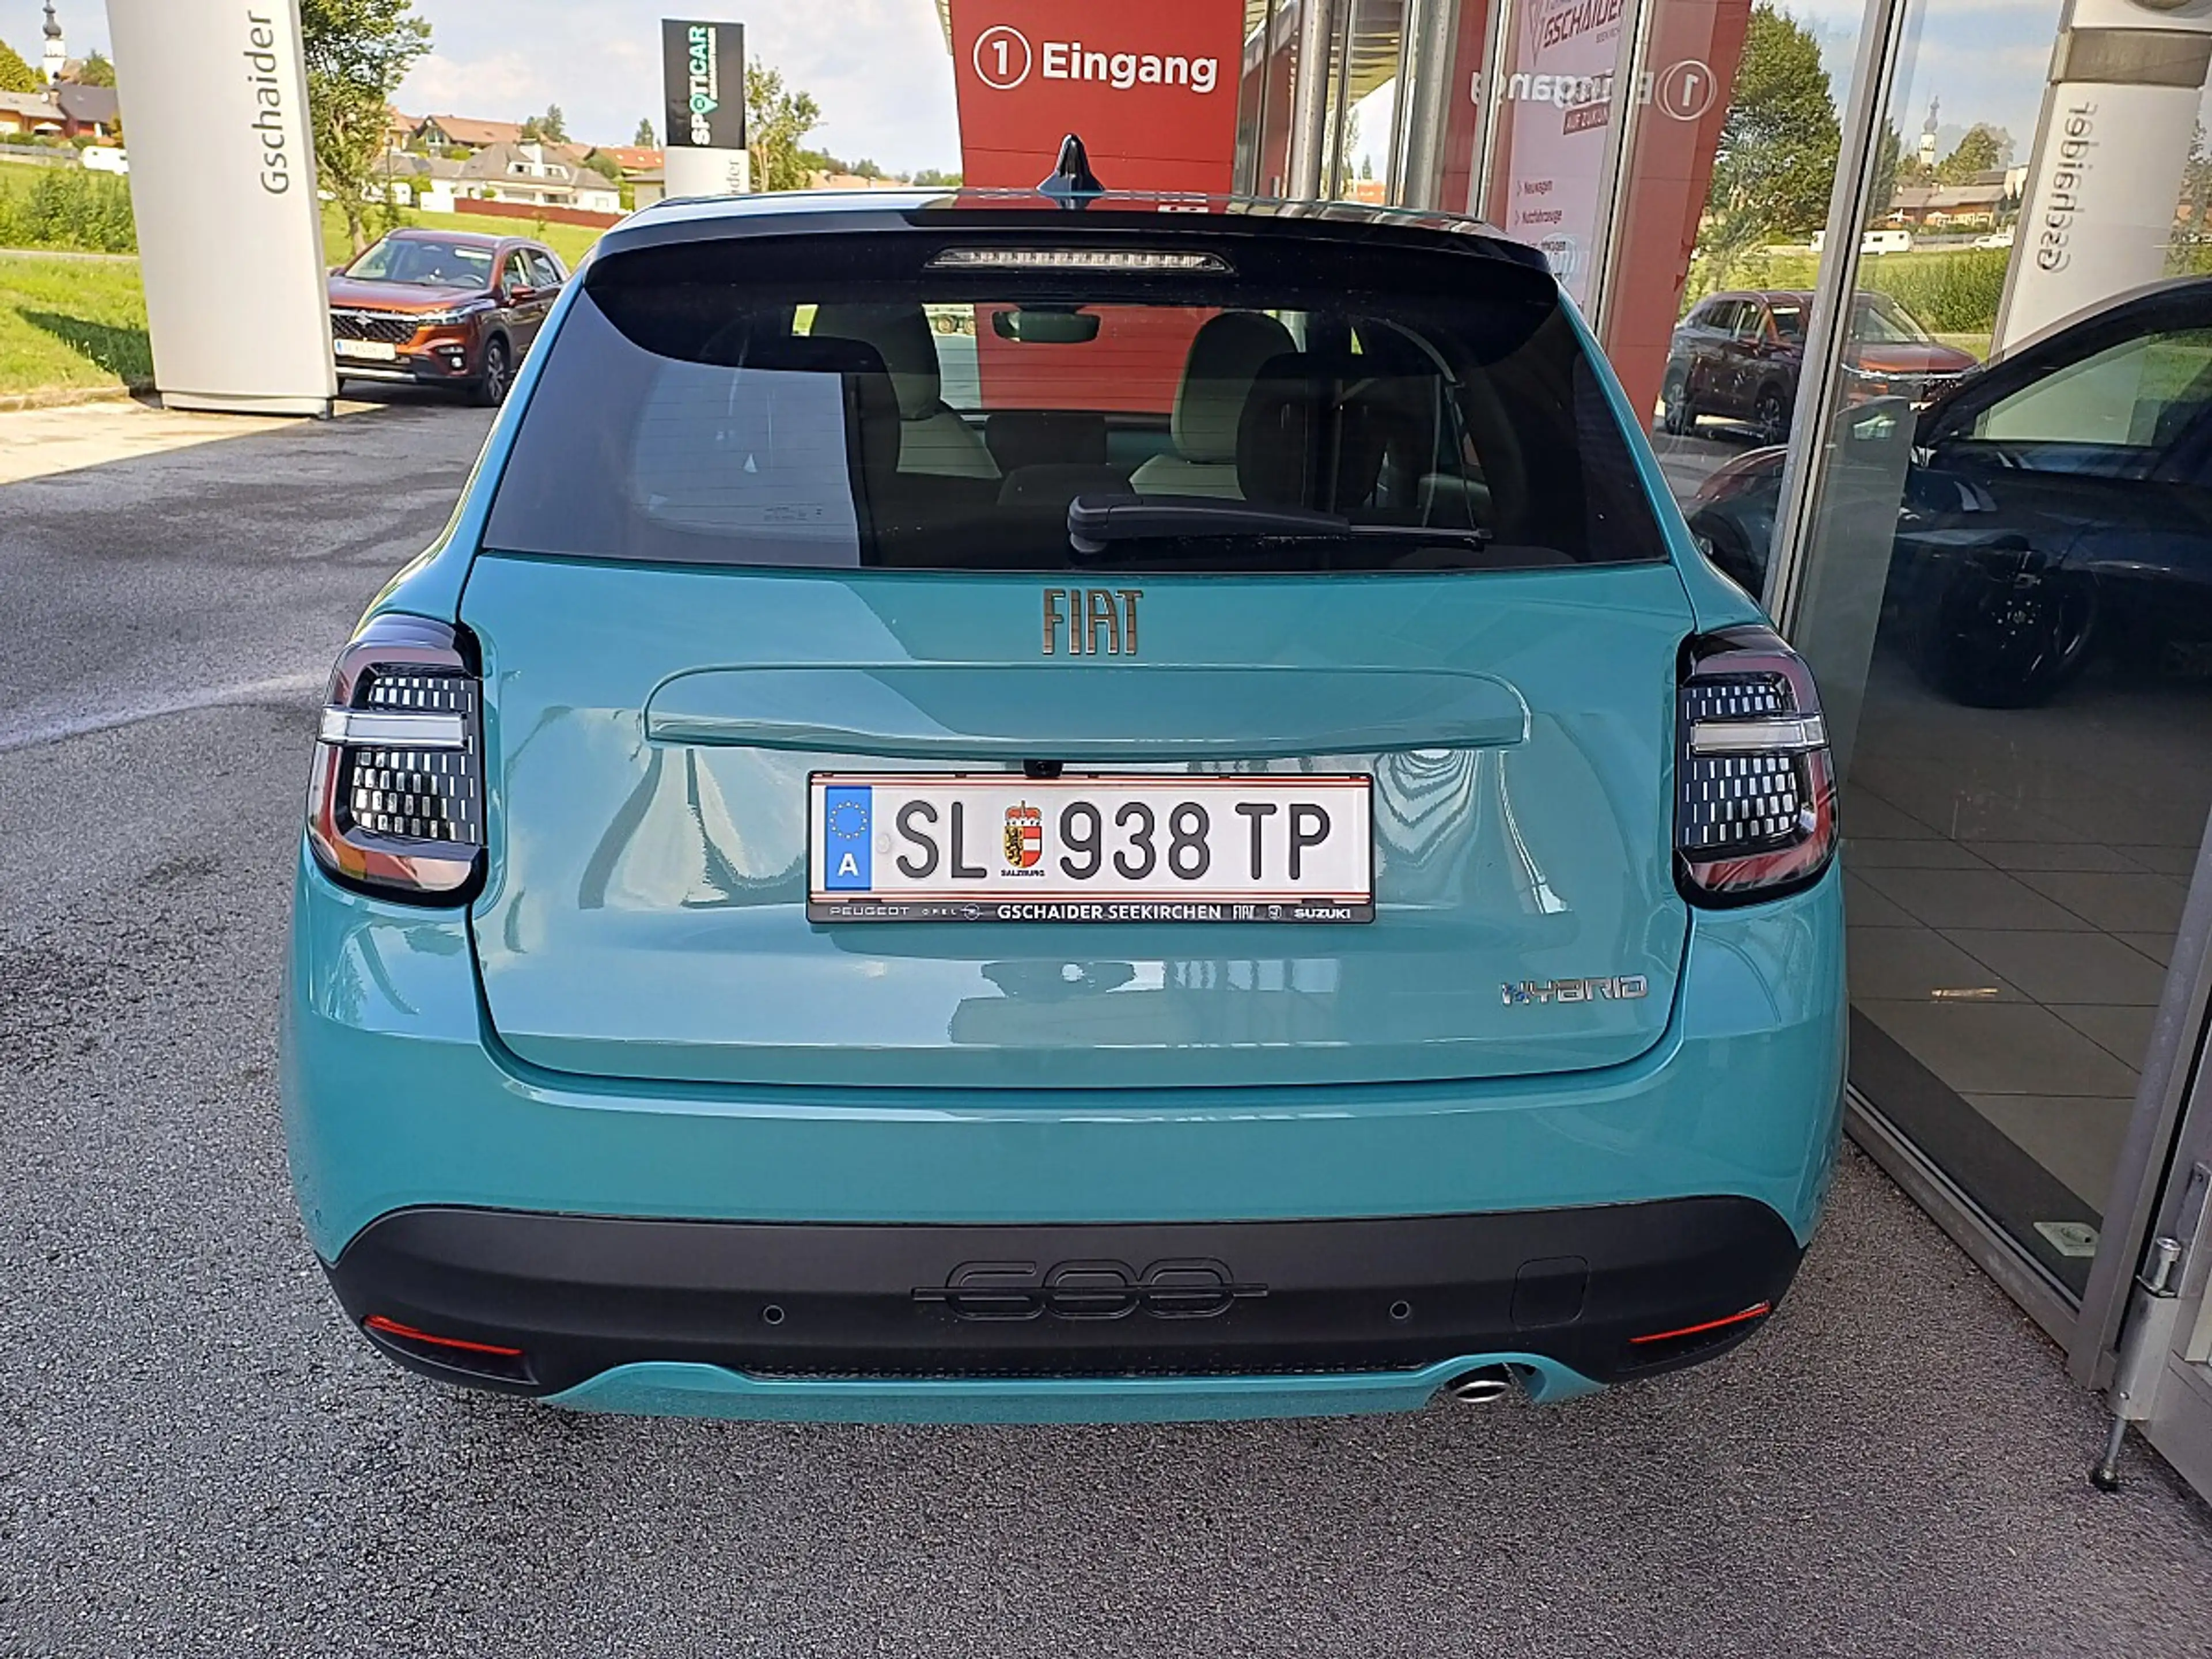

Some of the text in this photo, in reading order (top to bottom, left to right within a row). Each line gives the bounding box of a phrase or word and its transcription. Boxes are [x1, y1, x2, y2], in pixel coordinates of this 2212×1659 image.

[1543, 0, 1622, 48] GSCHAIDE
[689, 25, 718, 145] SPOTICAR
[1043, 41, 1218, 93] Eingang
[243, 9, 290, 194] Gschaider
[1043, 588, 1143, 655] FIAT
[838, 853, 859, 877] A
[896, 800, 1331, 880] SL 938 TP
[830, 907, 910, 915] PEUGEOT
[997, 904, 1103, 919] GSCHAIDER
[1108, 904, 1221, 919] SEEKIRCHEN
[1233, 905, 1256, 919] FIAT
[1294, 908, 1351, 919] SUZUKI
[1502, 975, 1647, 1005] HYBRID
